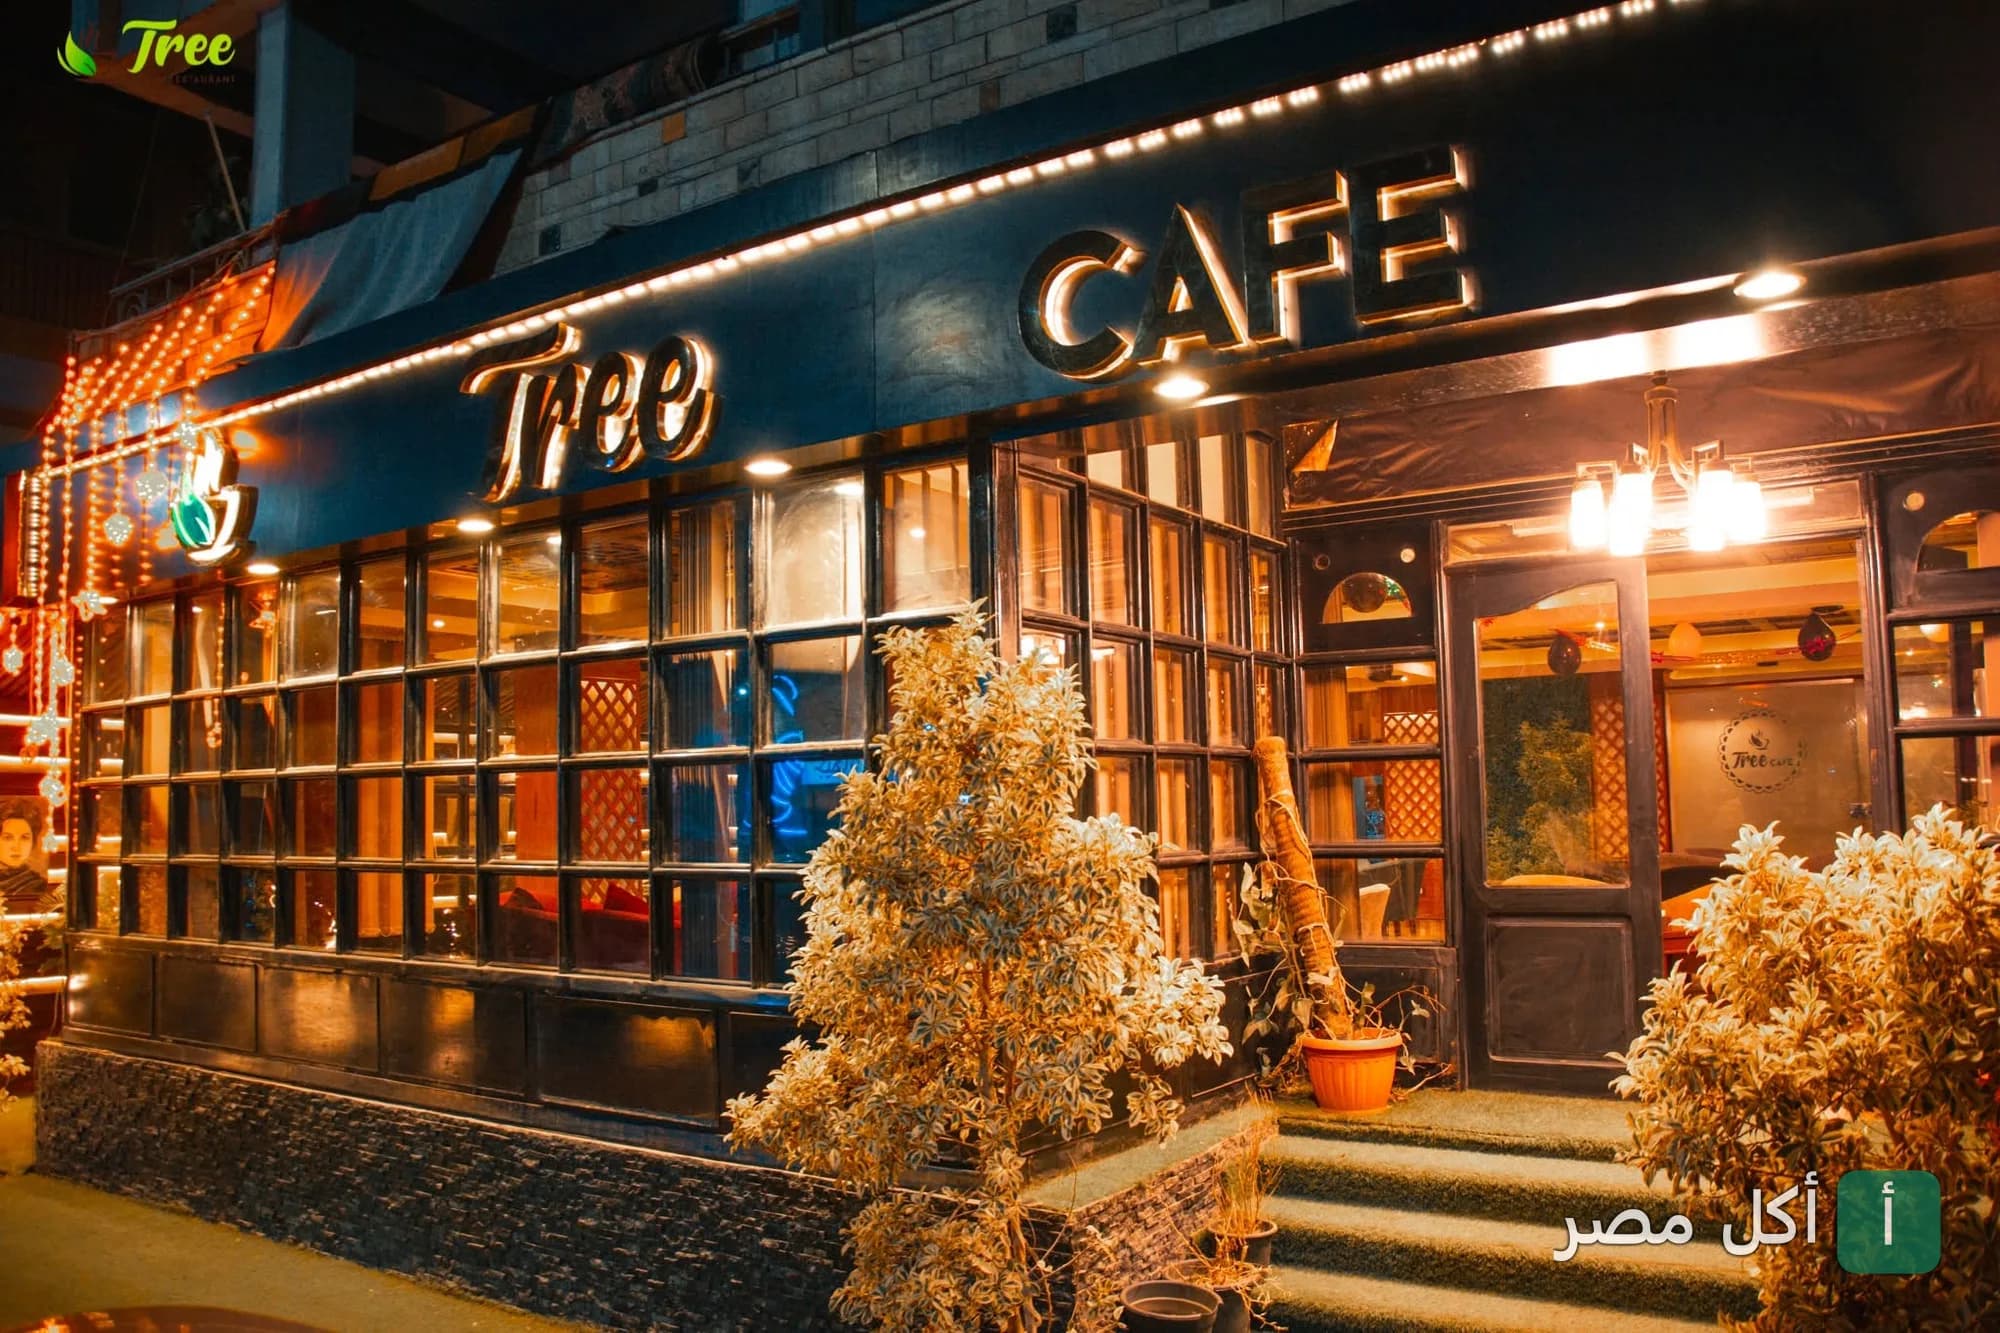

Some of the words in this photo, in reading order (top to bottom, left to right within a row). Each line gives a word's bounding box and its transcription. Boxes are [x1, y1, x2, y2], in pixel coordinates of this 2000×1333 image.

[1018, 144, 1478, 384] CAFE
[459, 319, 724, 503] Tree
[1732, 751, 1768, 768] Tree
